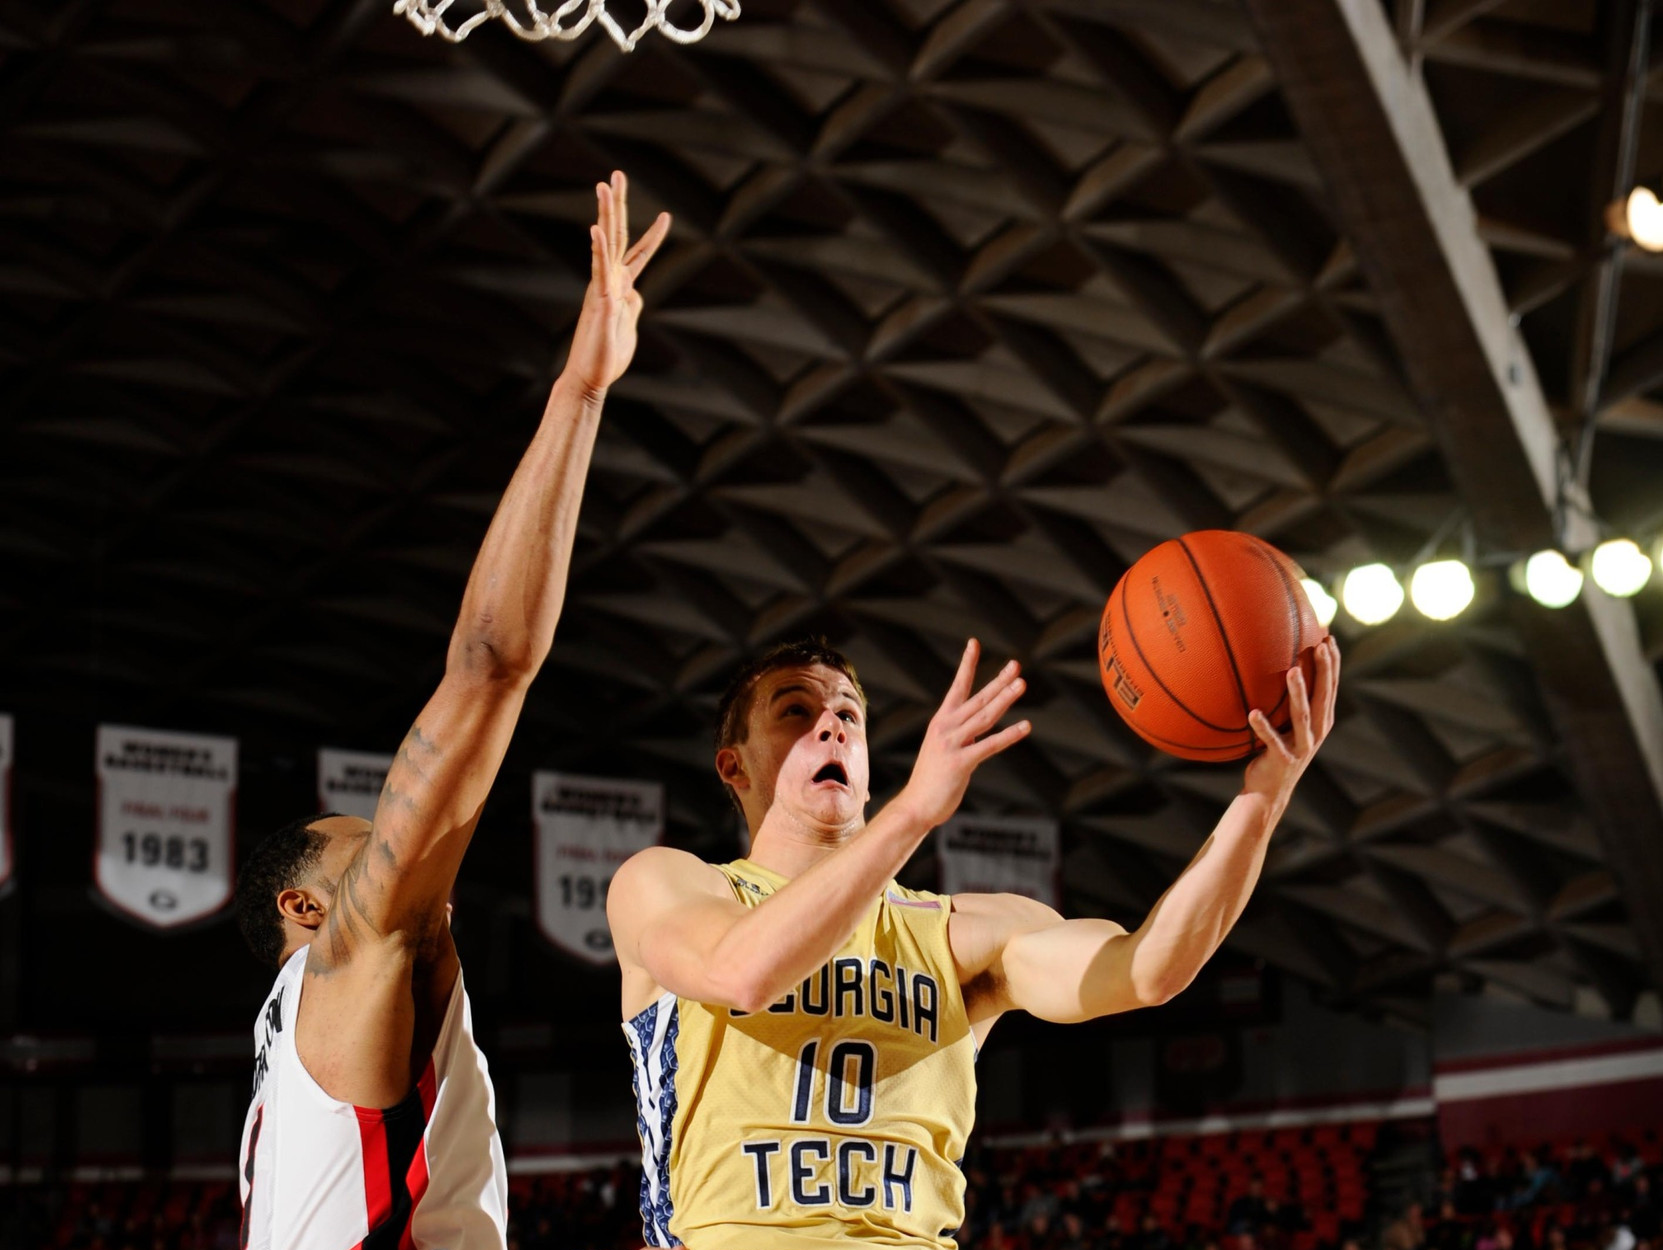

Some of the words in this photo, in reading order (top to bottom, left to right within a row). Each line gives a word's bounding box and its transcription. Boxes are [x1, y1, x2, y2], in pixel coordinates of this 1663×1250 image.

[122, 832, 210, 874] 1983
[559, 874, 610, 911] 19
[728, 956, 939, 1045] ORGIA
[789, 1036, 878, 1128] 10
[741, 1137, 919, 1213] TECH
